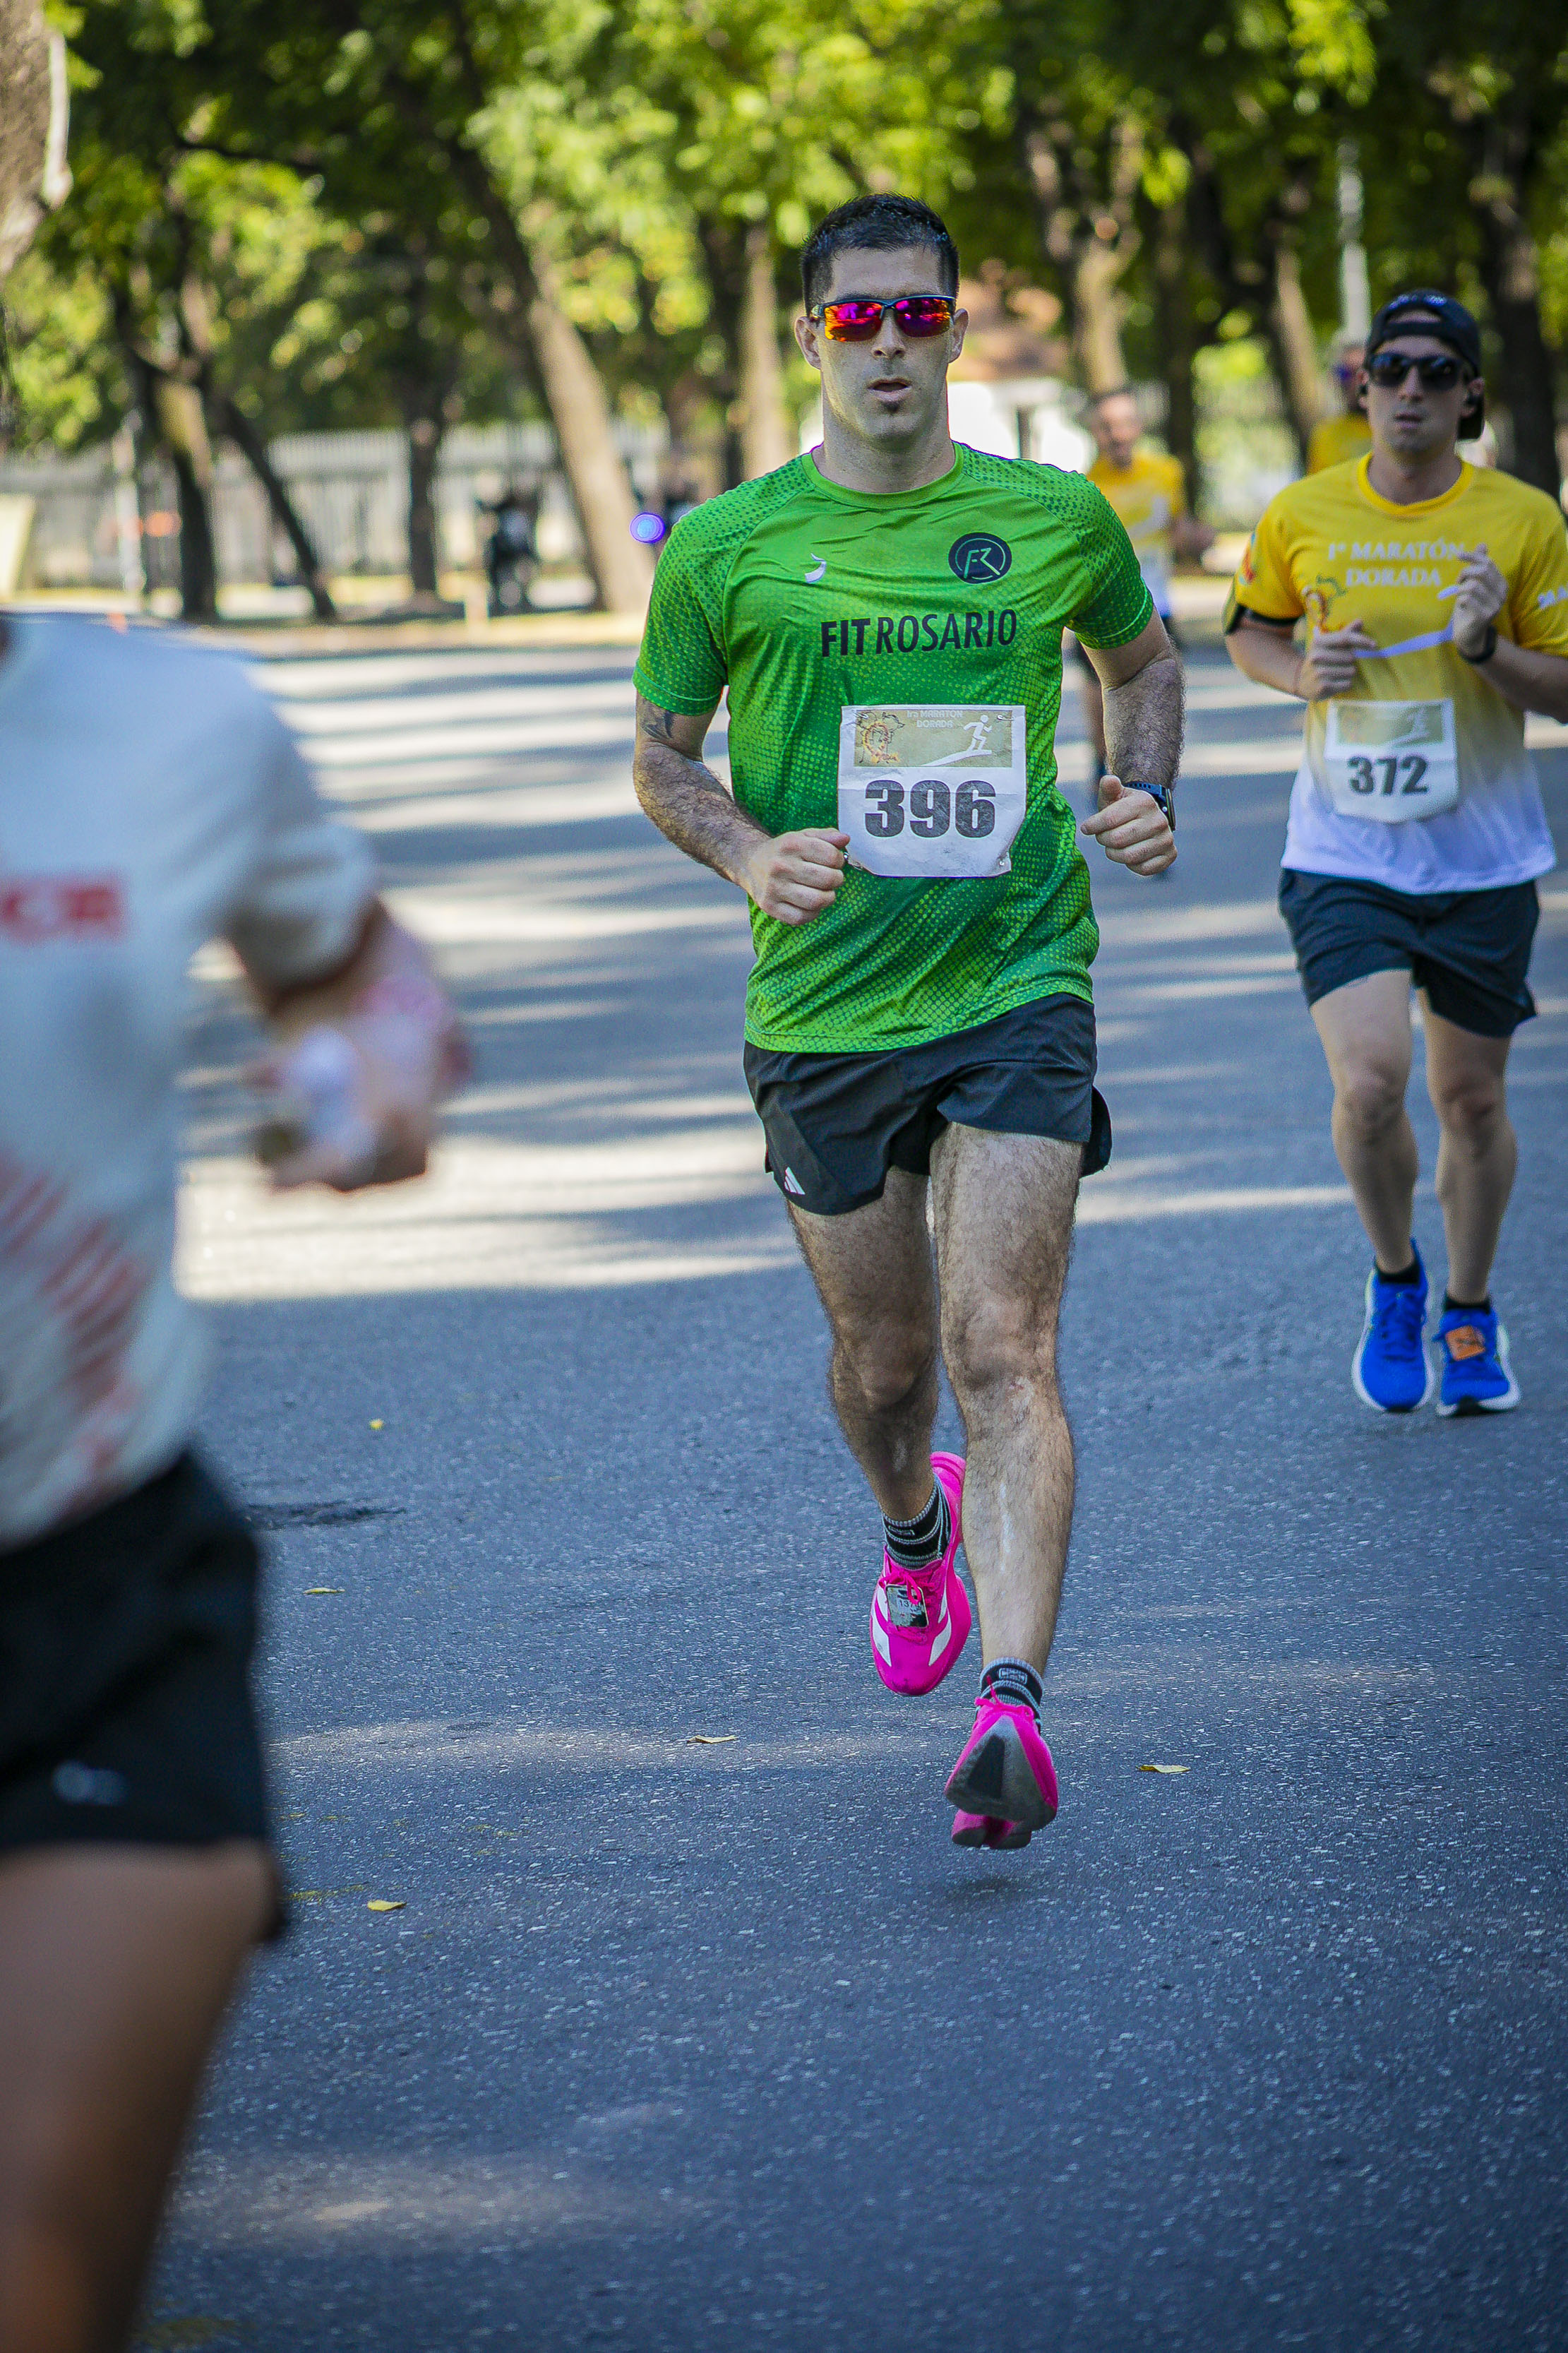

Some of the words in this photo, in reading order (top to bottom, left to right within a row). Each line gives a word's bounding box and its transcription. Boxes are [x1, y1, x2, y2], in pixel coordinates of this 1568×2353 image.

[1346, 568, 1442, 586] DORADA
[916, 720, 954, 728] DORADA
[1347, 754, 1430, 796] 372
[864, 780, 997, 838] 396
